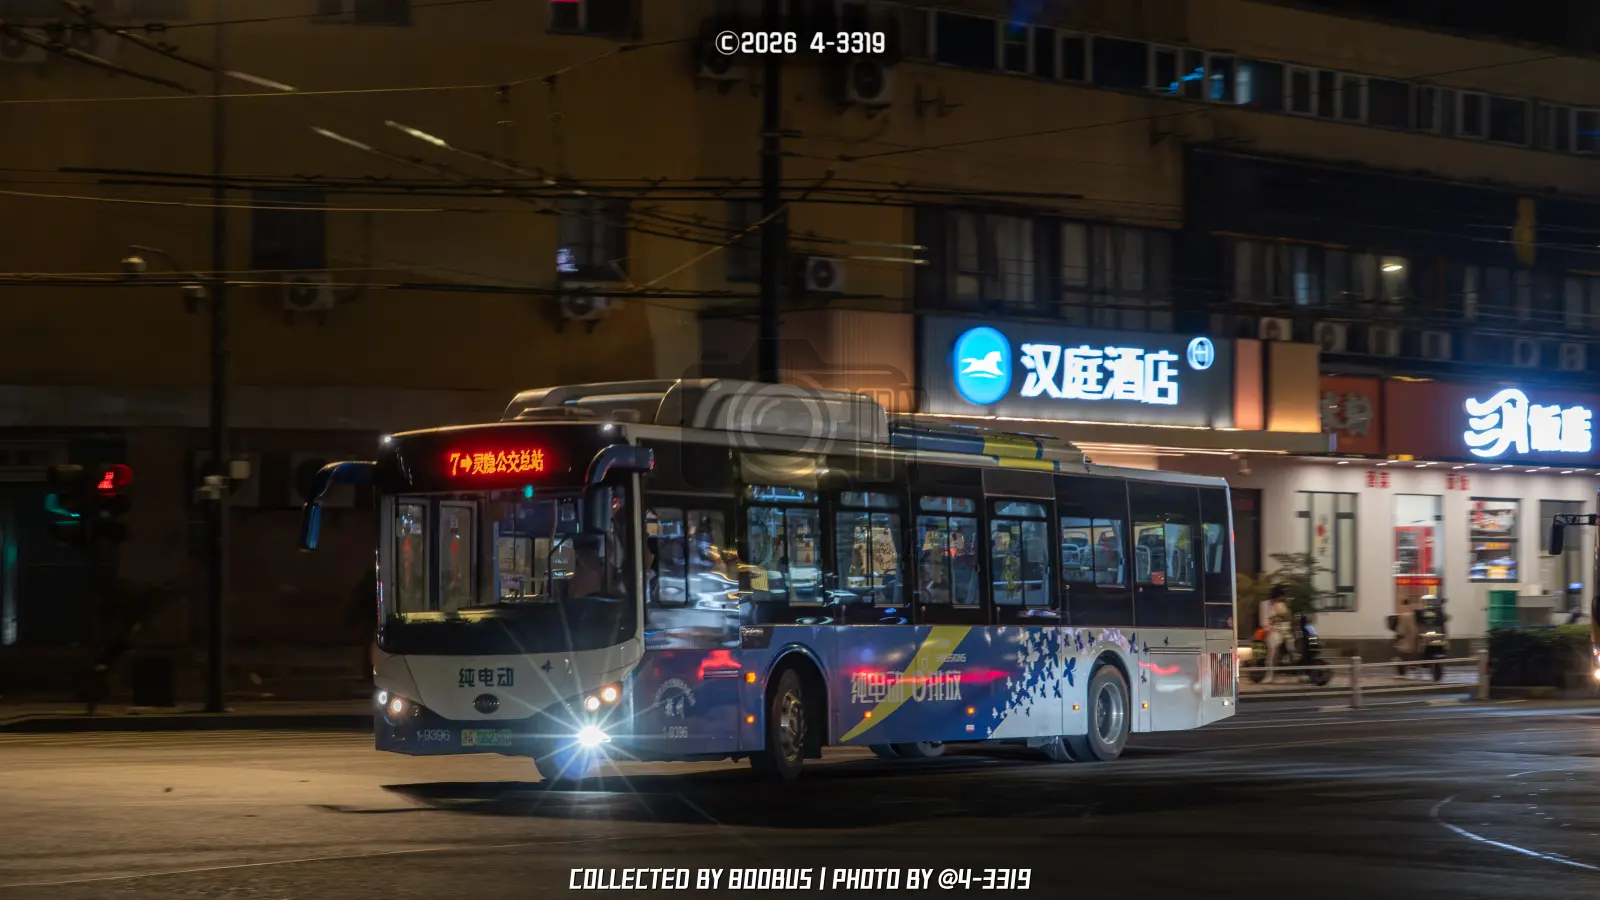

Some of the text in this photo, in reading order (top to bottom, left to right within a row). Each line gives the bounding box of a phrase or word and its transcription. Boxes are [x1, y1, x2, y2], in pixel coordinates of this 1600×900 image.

[1020, 342, 1179, 405] 汉庭酒店
[449, 448, 544, 475] 7 灵隐公交总站
[458, 667, 515, 688] 纯电动
[851, 670, 904, 704] 纯电动
[416, 729, 451, 741] 1-9396
